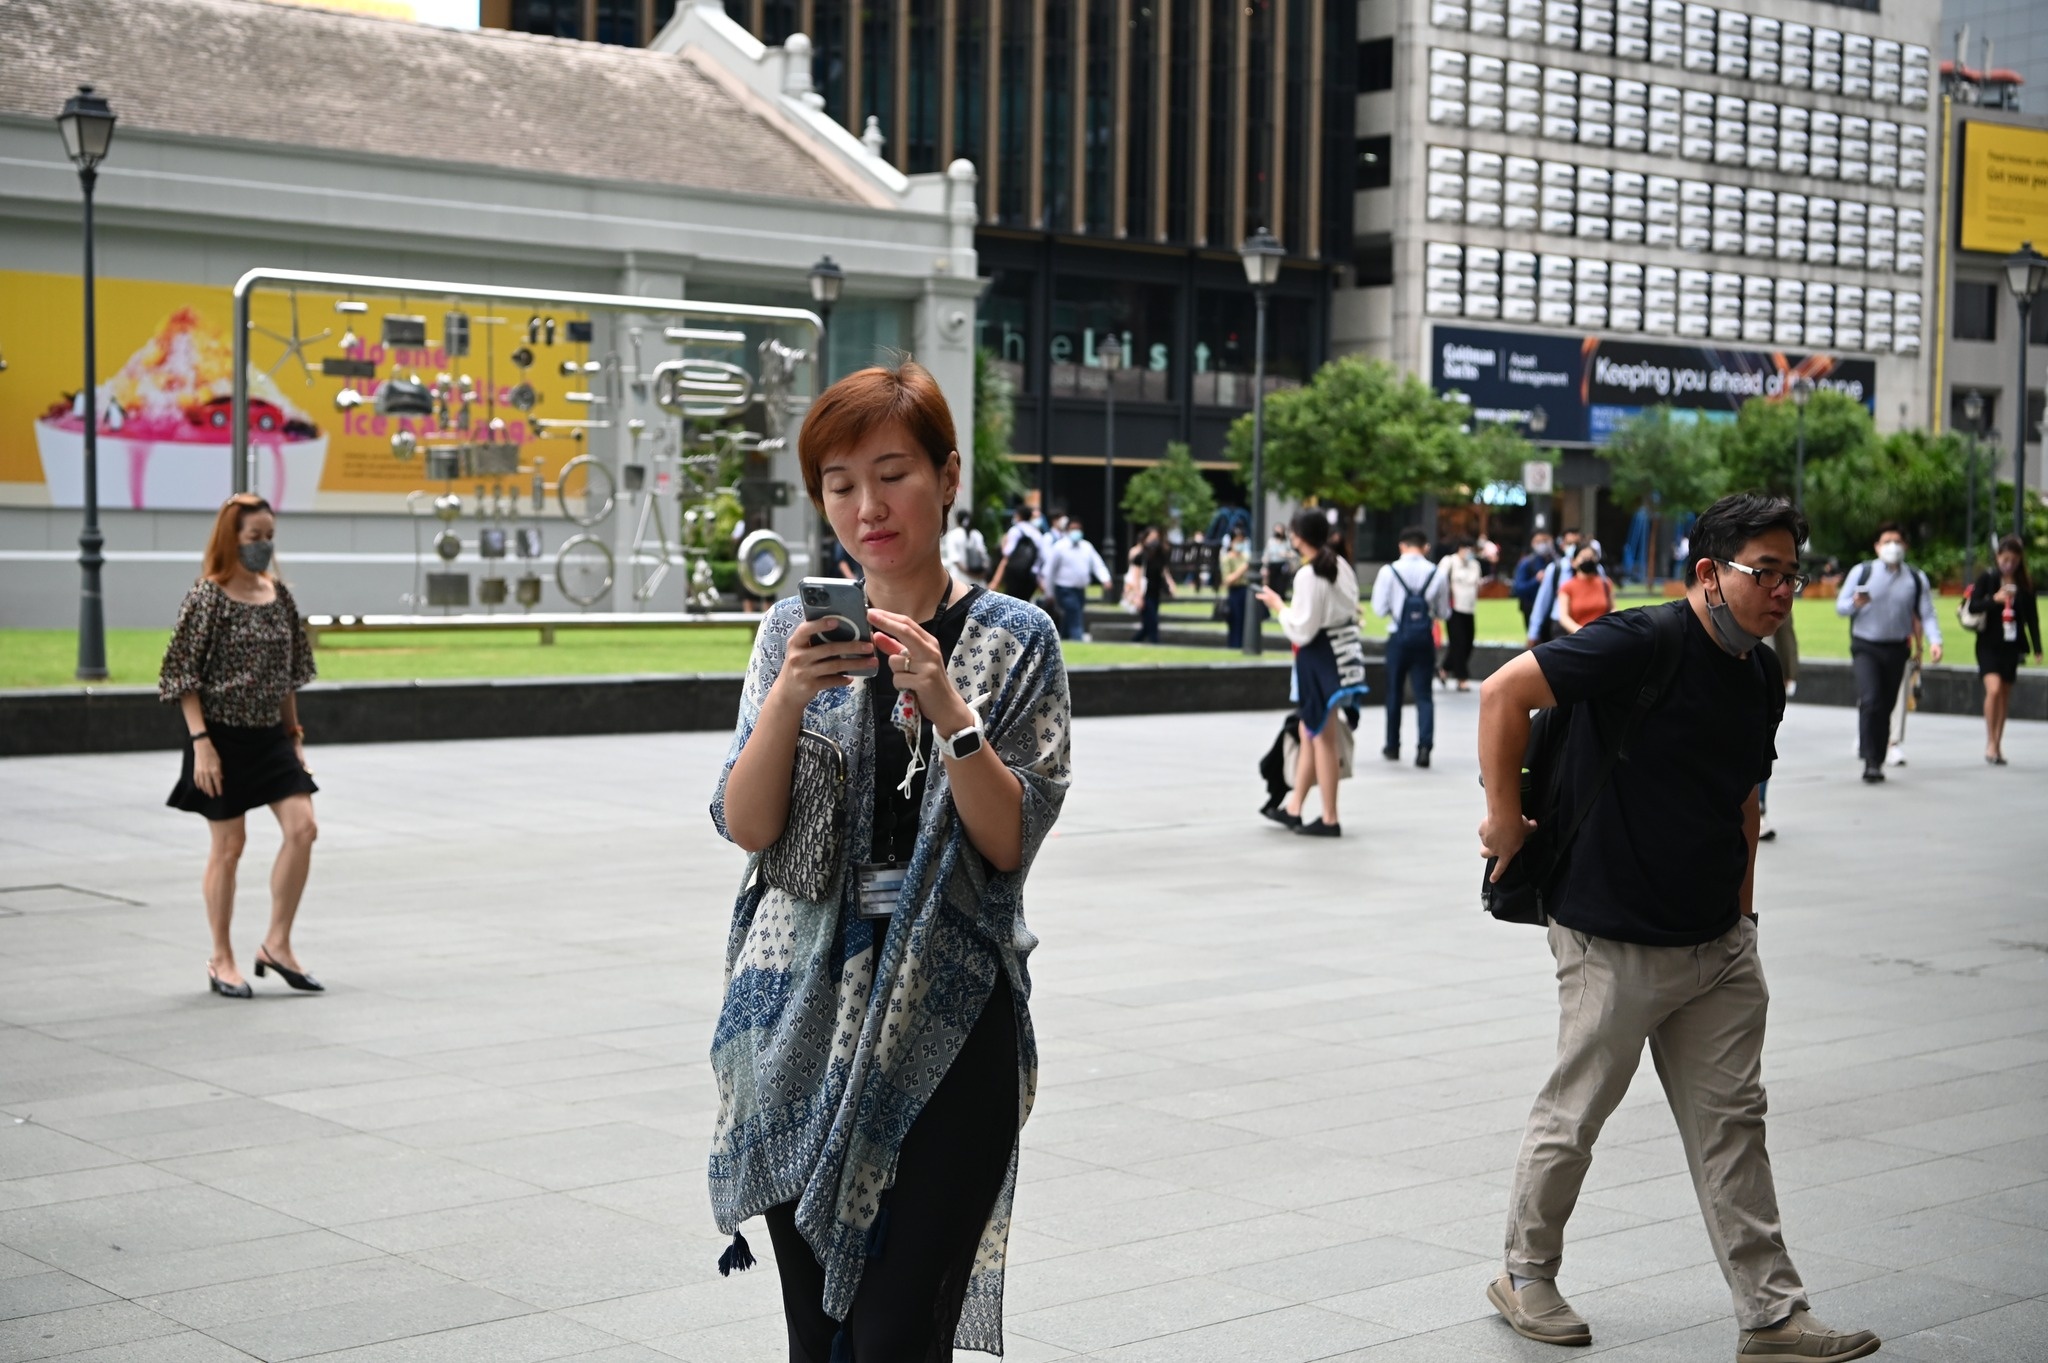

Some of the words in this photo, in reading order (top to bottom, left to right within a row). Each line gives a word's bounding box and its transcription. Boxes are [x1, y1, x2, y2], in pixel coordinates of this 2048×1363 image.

[1595, 356, 1670, 396] Keeping
[1672, 367, 1706, 397] you
[1708, 364, 1763, 396] ahead
[1765, 368, 1785, 396] of
